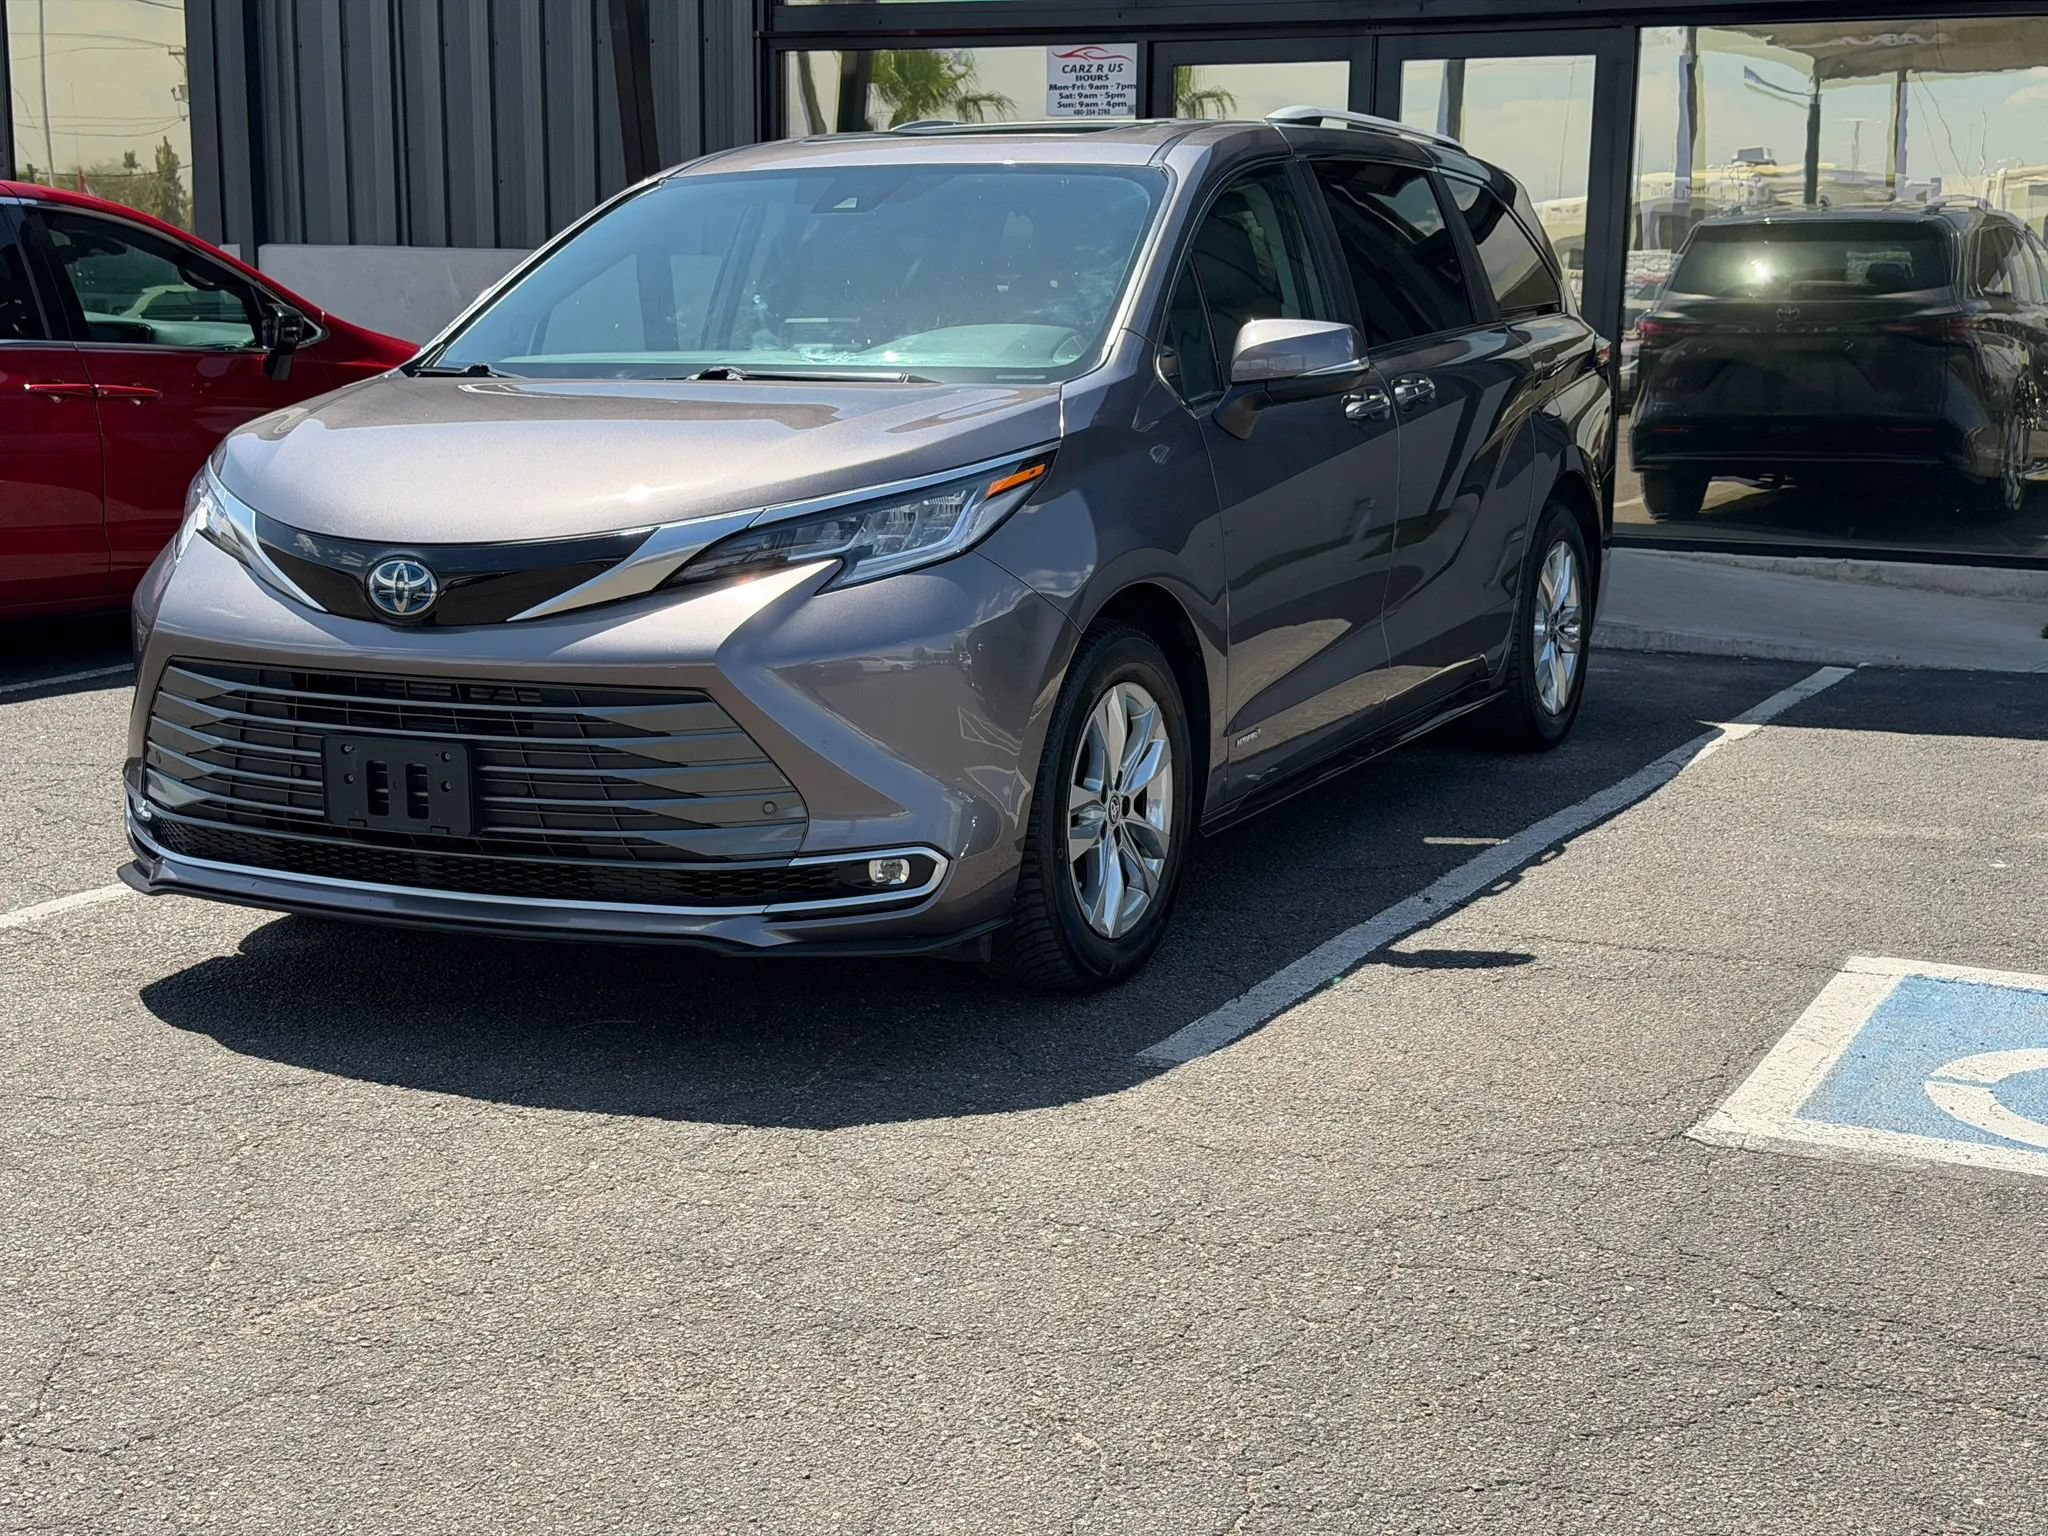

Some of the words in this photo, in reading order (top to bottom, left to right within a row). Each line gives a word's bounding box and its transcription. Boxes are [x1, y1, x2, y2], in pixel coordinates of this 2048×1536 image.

[1061, 64, 1094, 74] CARZ
[1096, 64, 1104, 73] R
[1108, 63, 1124, 73] US
[1075, 74, 1110, 82] HOURS
[1049, 83, 1086, 91] Mon-Fri:
[1115, 83, 1136, 91] 7pm
[1058, 92, 1076, 100] Sat:
[1105, 92, 1126, 100] 5pm
[1057, 101, 1076, 109] Sun:
[1106, 100, 1127, 109] 4pm
